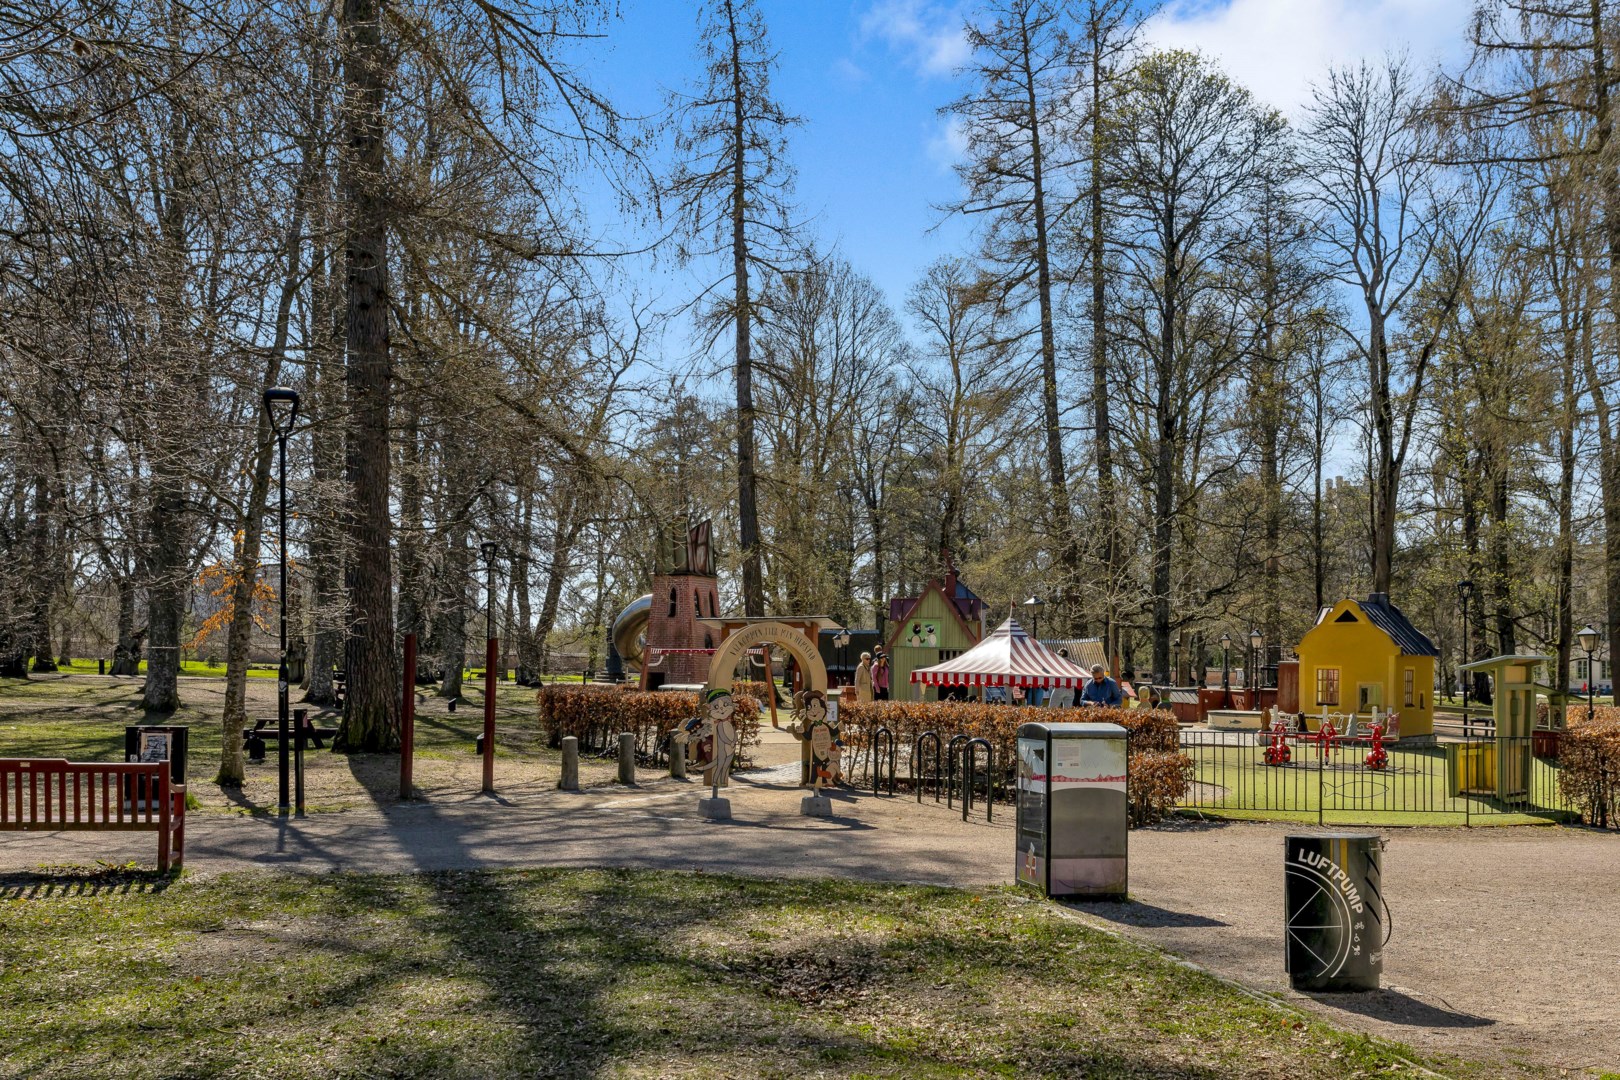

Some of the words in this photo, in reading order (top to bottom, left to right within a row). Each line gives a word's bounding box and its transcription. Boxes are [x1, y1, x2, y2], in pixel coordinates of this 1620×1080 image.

[765, 627, 778, 636] TILL
[780, 628, 792, 640] MIN
[1298, 848, 1363, 914] LUFTPUMP
